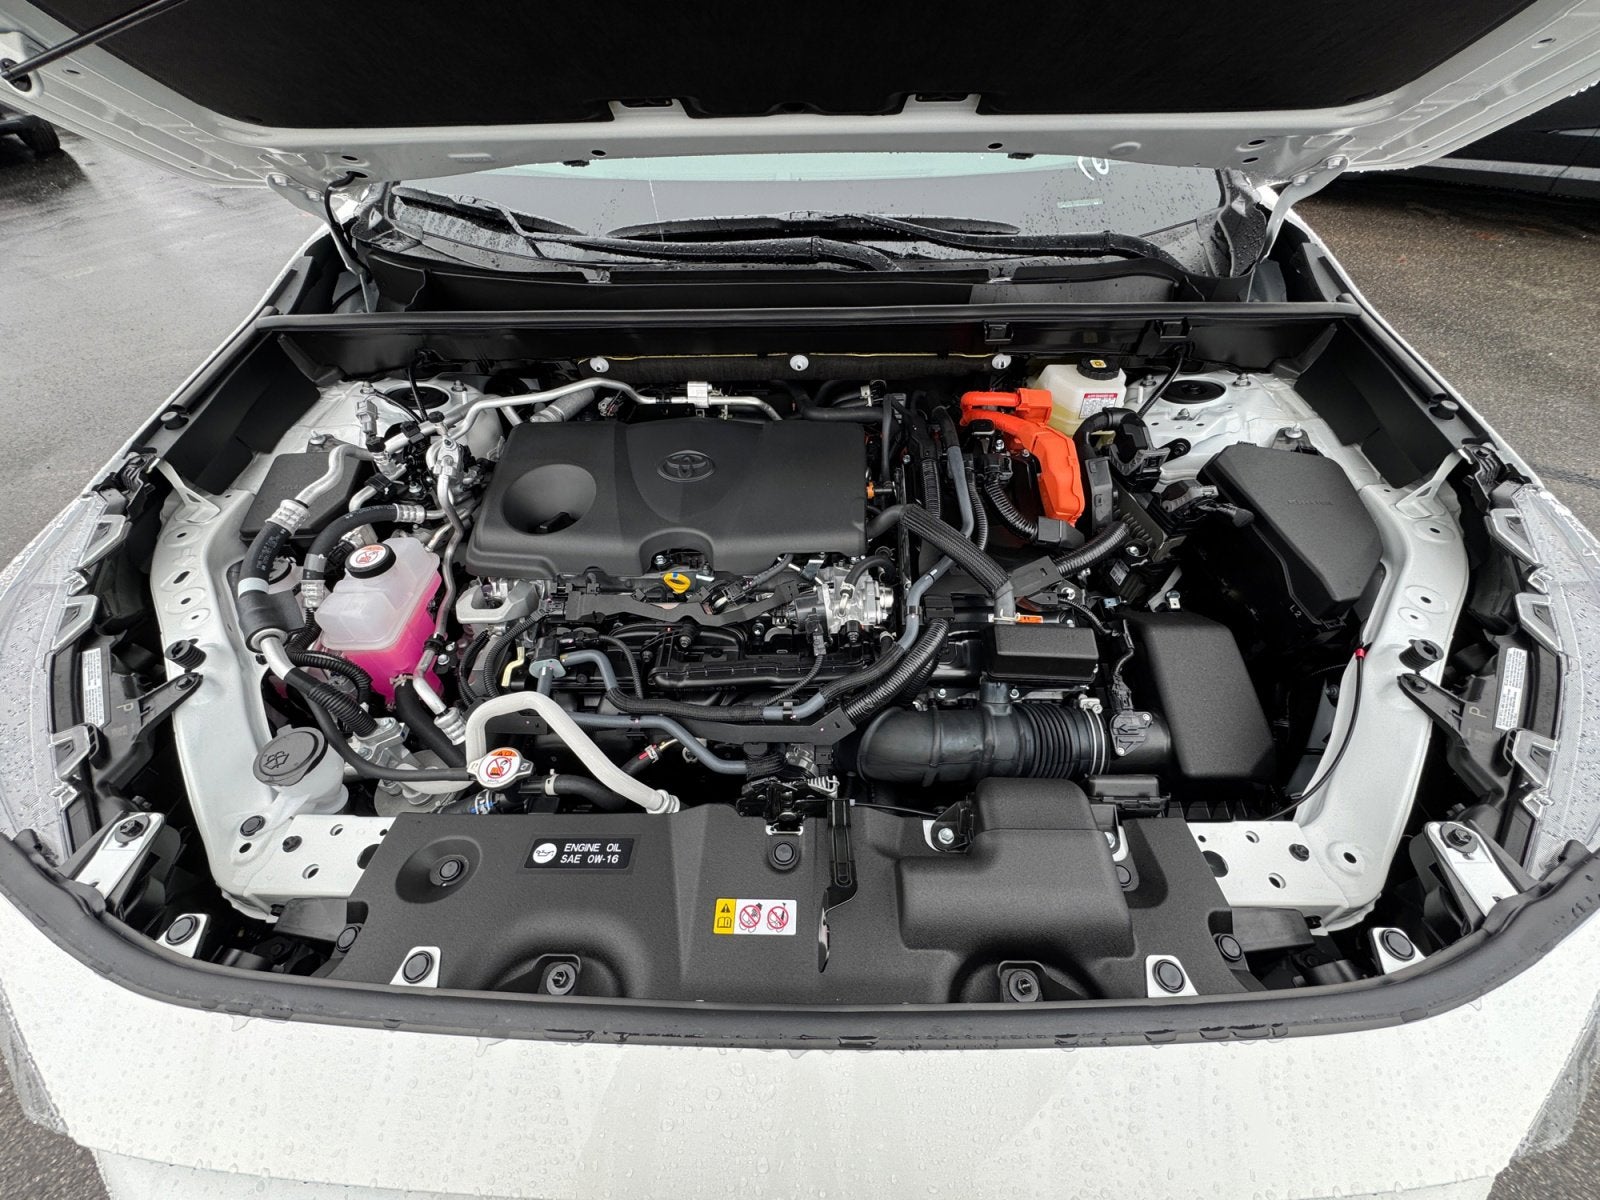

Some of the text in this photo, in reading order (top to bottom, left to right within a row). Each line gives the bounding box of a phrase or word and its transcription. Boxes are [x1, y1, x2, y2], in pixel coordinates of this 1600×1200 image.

[563, 843, 621, 852] ENGINE OIL
[560, 854, 619, 864] SAE 0W-16
